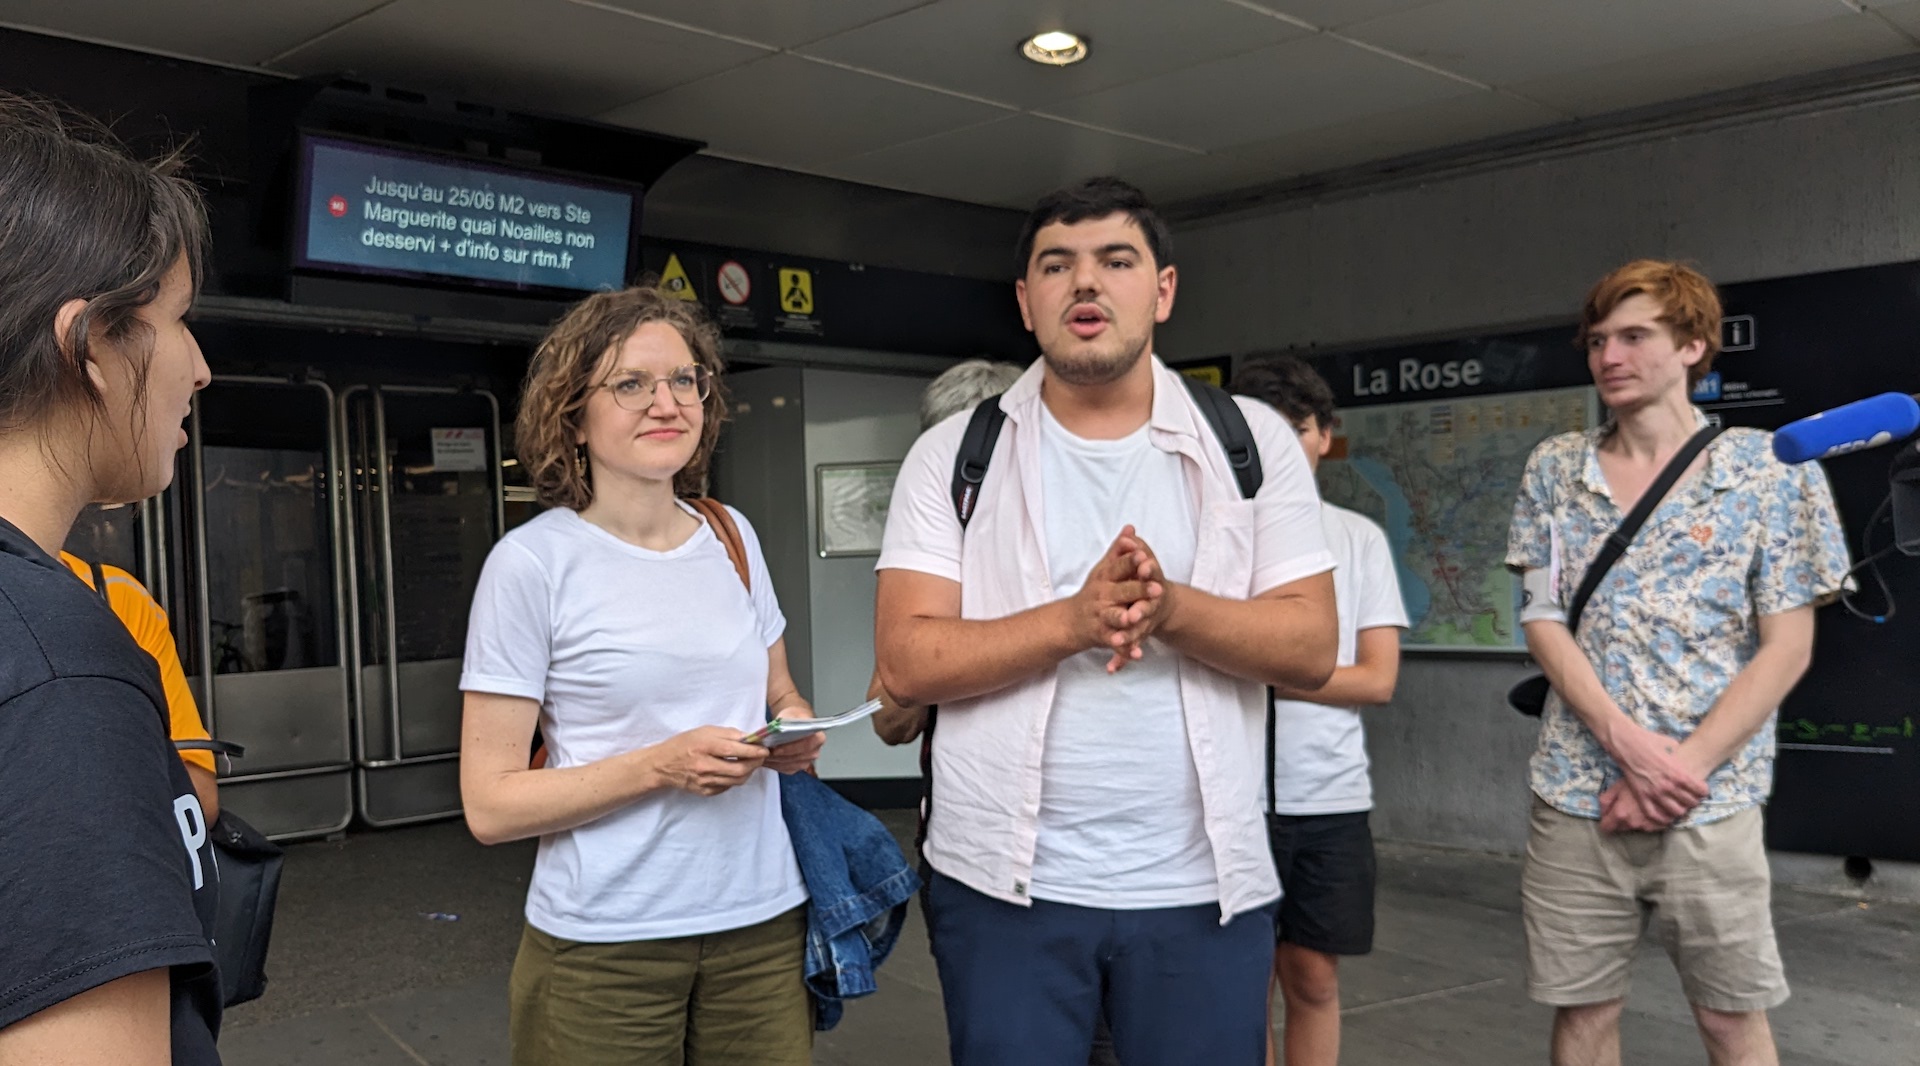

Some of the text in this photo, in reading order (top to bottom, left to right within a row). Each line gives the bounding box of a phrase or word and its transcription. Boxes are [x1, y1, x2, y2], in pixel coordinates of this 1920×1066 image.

[365, 176, 592, 224] Jusqu'au 25/06 M2 vers Ste
[364, 201, 595, 249] Marguerite quai Noailles non
[362, 227, 574, 270] desservi + d'info sur rtm.fr
[1353, 358, 1481, 396] La Rose
